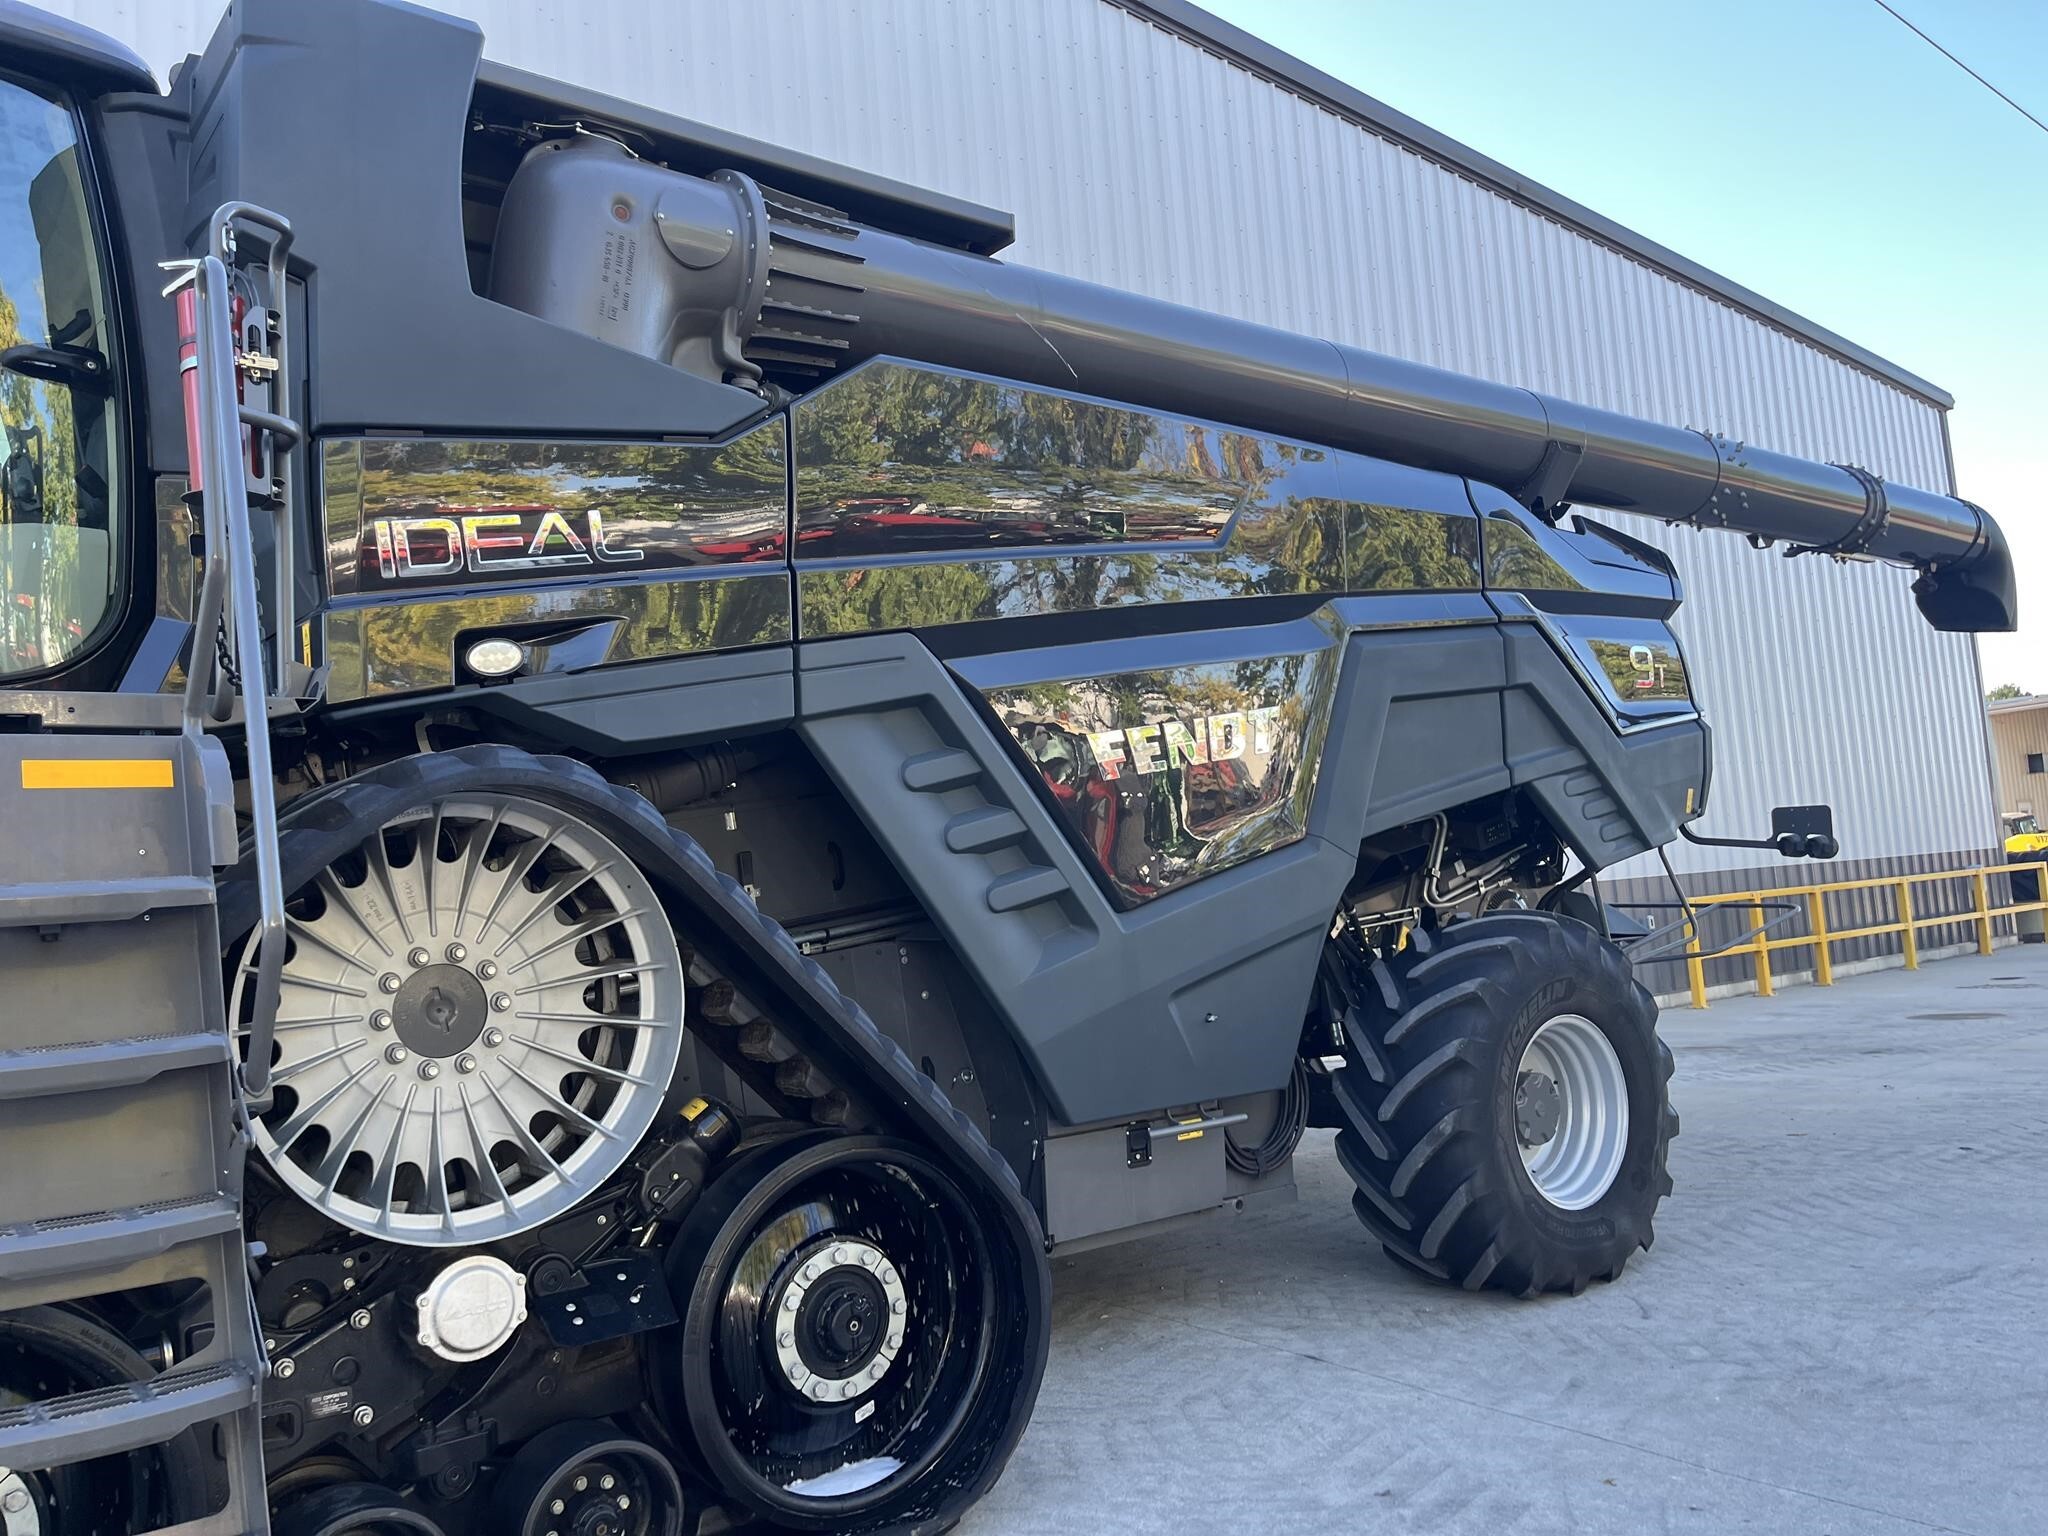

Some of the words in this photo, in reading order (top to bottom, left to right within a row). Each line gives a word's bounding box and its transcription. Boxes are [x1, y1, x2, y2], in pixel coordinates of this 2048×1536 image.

[374, 509, 644, 579] IDEAL
[1629, 645, 1668, 689] 9T
[1087, 705, 1281, 781] FENDT
[1501, 979, 1568, 1087] MICHELIN
